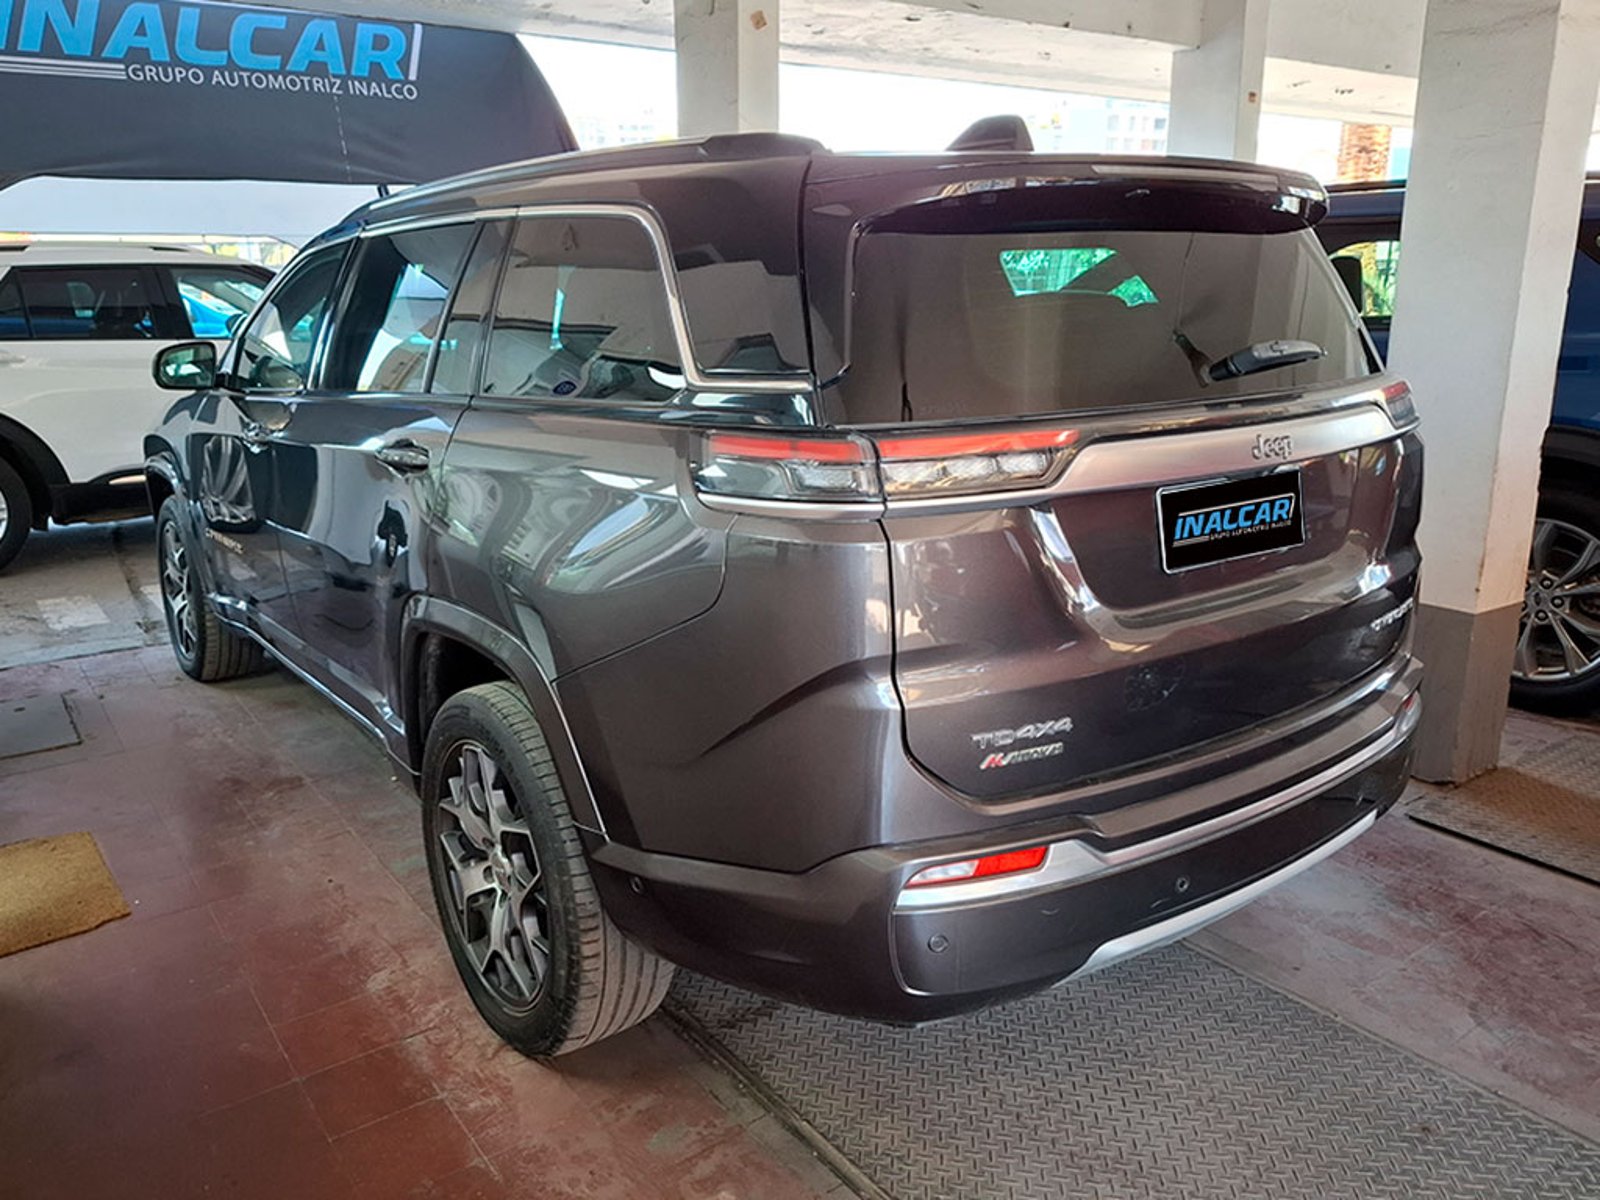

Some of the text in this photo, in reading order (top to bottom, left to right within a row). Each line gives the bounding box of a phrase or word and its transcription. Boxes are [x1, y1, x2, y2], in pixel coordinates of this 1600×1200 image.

[127, 63, 419, 101] GRUPO AUTOMOTRIZ INALCO
